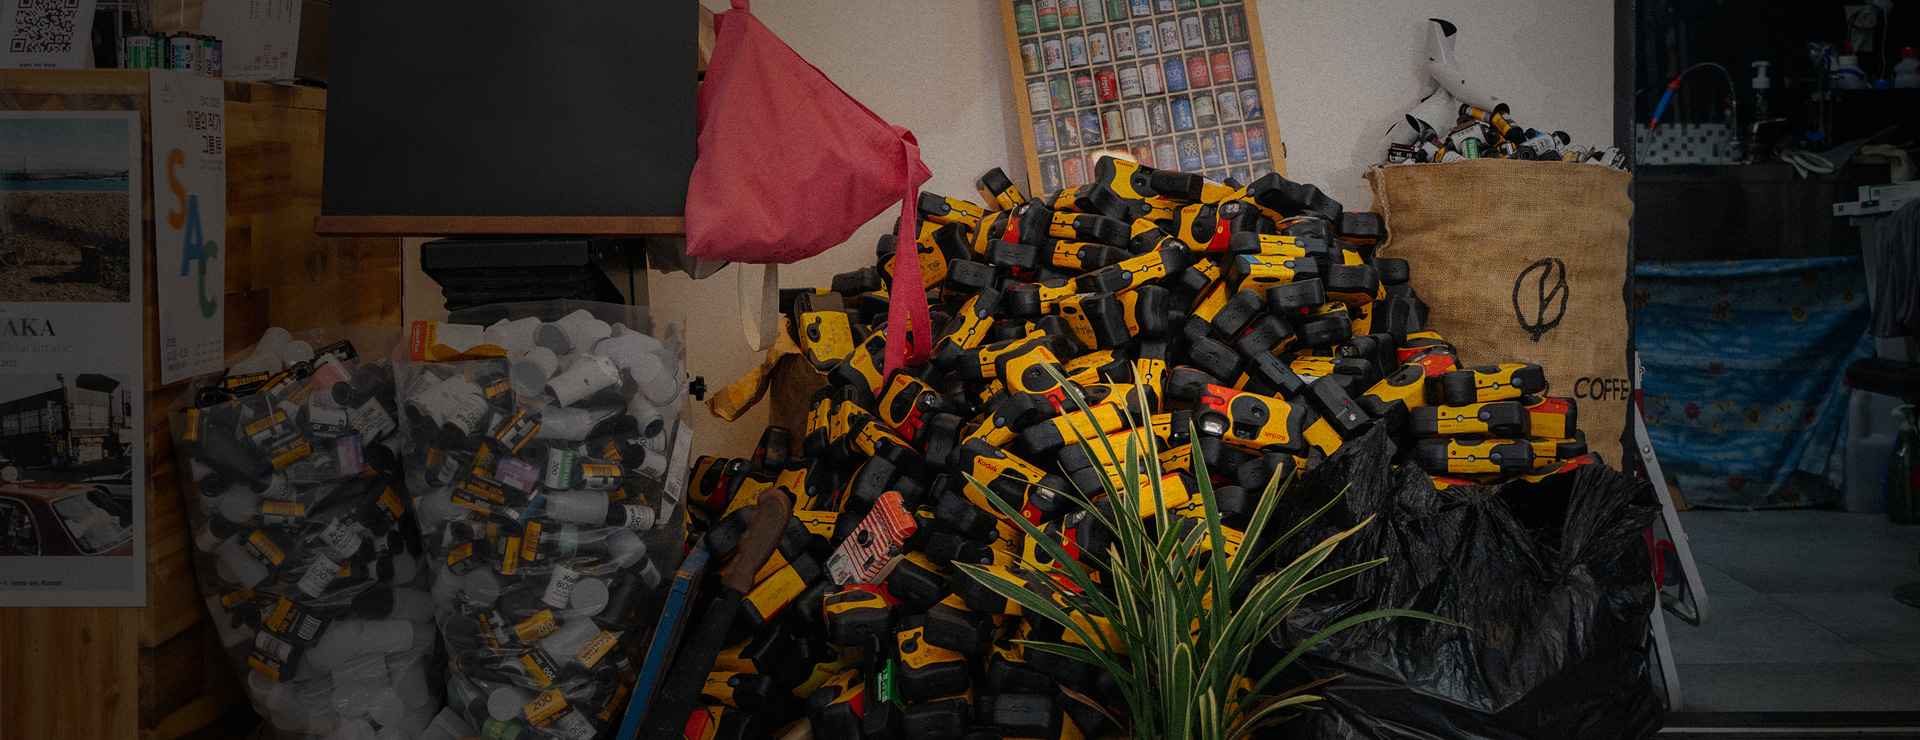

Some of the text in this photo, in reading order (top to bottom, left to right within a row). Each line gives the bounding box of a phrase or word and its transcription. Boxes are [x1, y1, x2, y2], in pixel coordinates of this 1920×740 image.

[1115, 32, 1123, 52] ILFORD
[1137, 30, 1148, 50] FP4
[175, 44, 184, 69] FP4
[187, 110, 221, 132] 이달의 작가
[1152, 105, 1163, 132] YASHICA
[1177, 101, 1187, 128] YASHICA
[1184, 141, 1196, 149] 100
[1185, 148, 1198, 156] VX
[0, 318, 56, 336] AKA
[852, 353, 867, 365] Kodak
[1039, 347, 1051, 361] Kodak
[293, 385, 316, 405] odak
[290, 437, 304, 448] 200
[1264, 430, 1286, 441] Kodak
[481, 453, 495, 467] 200
[977, 458, 998, 473] Kodak
[551, 461, 560, 476] 200
[561, 453, 573, 487] FUJIFILM
[793, 471, 805, 489] Kodak
[475, 499, 491, 509] 200
[331, 530, 346, 545] 800
[556, 580, 574, 591] 800
[279, 621, 289, 633] 200
[534, 621, 554, 635] 200
[582, 633, 612, 659] Kodak
[267, 660, 281, 671] 200
[817, 665, 835, 674] Kodak
[543, 667, 556, 681] 200
[532, 694, 553, 711] 200
[570, 719, 586, 735] 800
